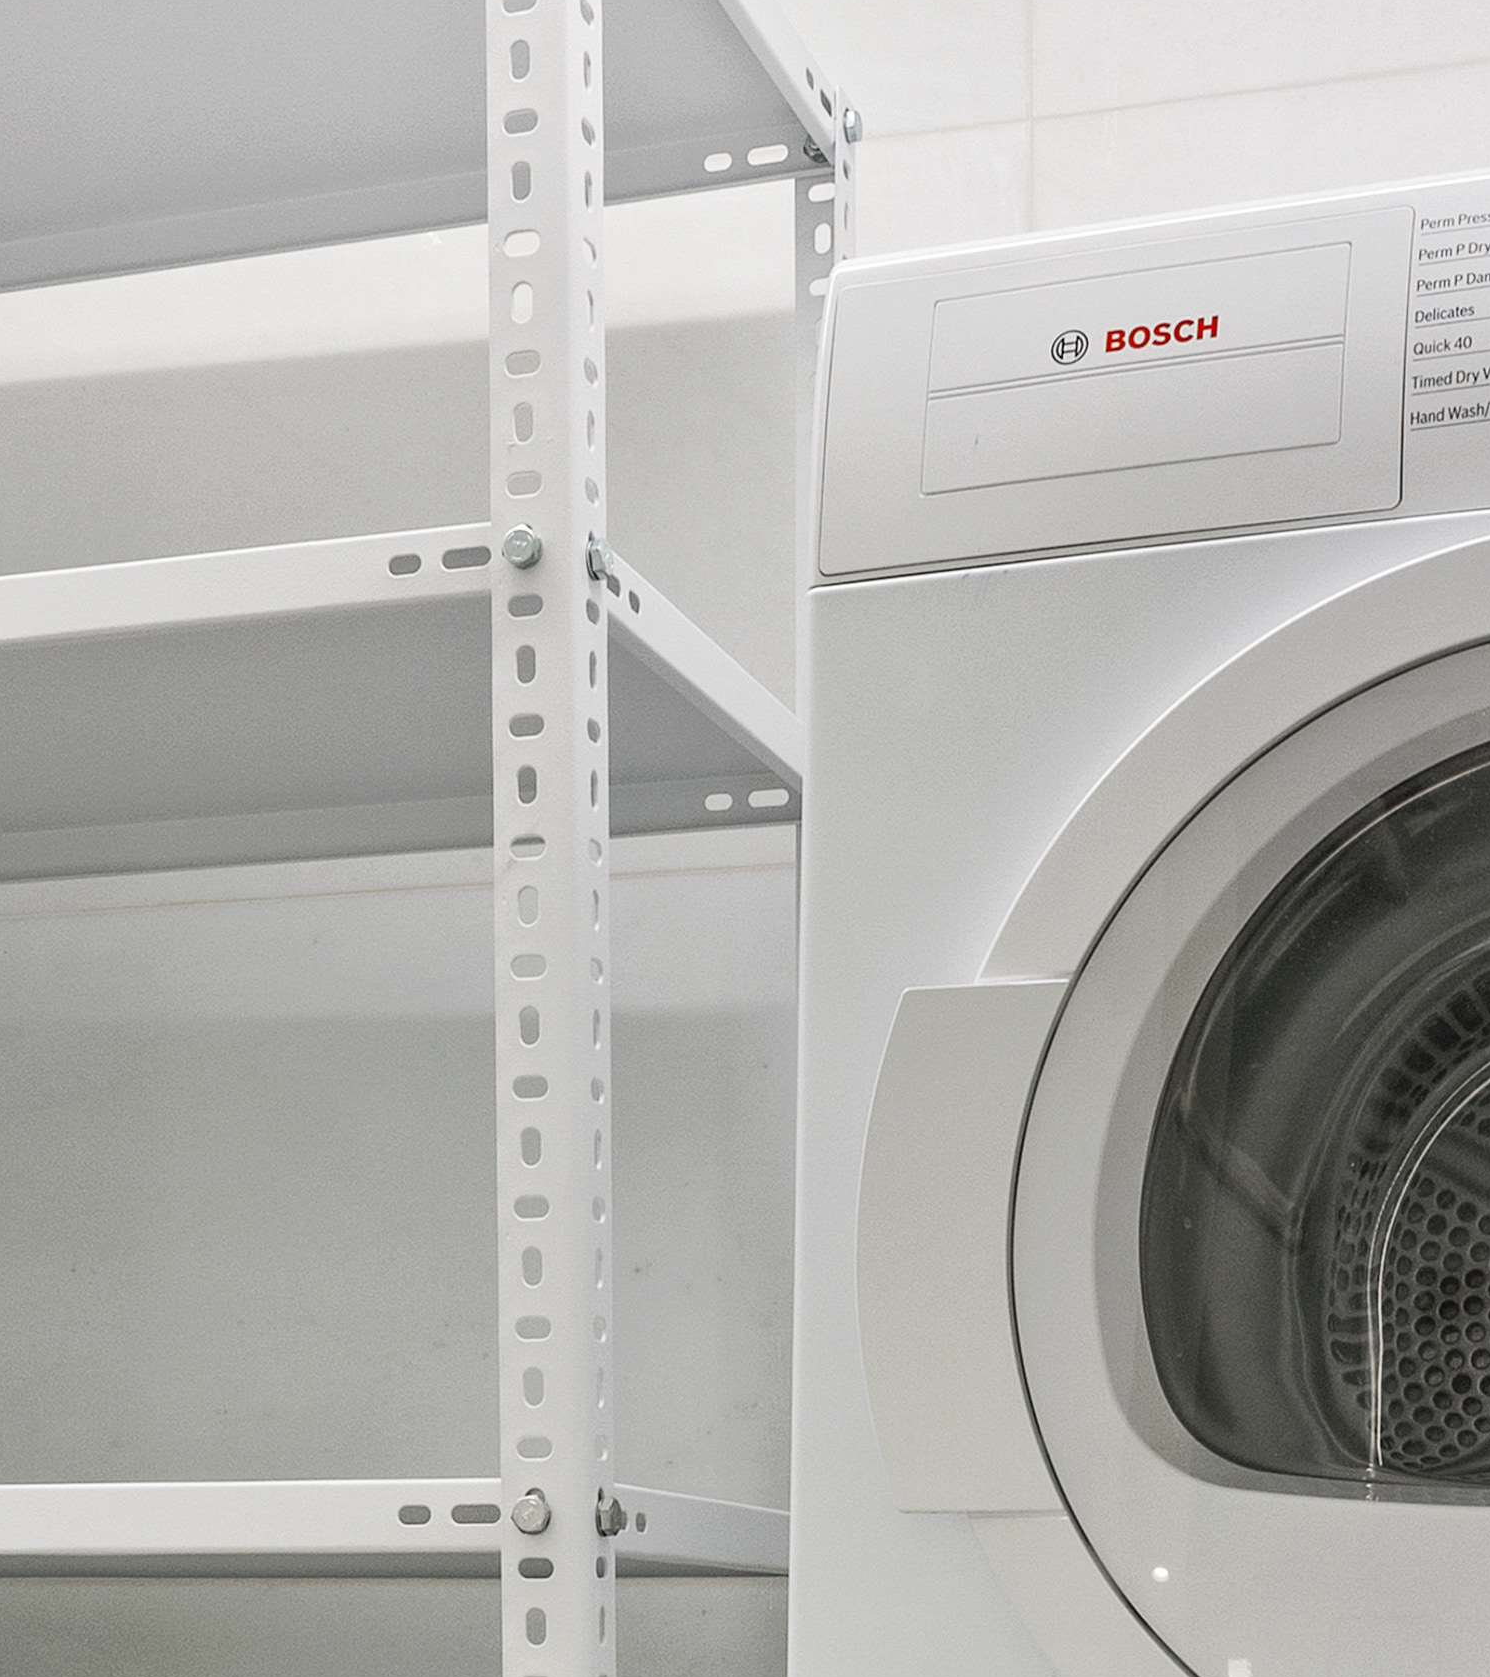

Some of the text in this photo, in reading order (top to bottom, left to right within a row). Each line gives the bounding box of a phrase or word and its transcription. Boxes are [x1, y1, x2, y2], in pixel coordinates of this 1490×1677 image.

[1421, 217, 1454, 230] Perm
[1419, 248, 1452, 260] Perm
[1456, 245, 1465, 257] P
[1416, 279, 1450, 291] Perm
[1455, 275, 1463, 287] P
[1415, 306, 1474, 323] Delicates
[1106, 315, 1219, 352] BOSCH
[1413, 336, 1472, 356] Quick 40
[1412, 372, 1452, 389] Timed
[1456, 369, 1478, 383] Dry
[1411, 407, 1444, 425] Hand
